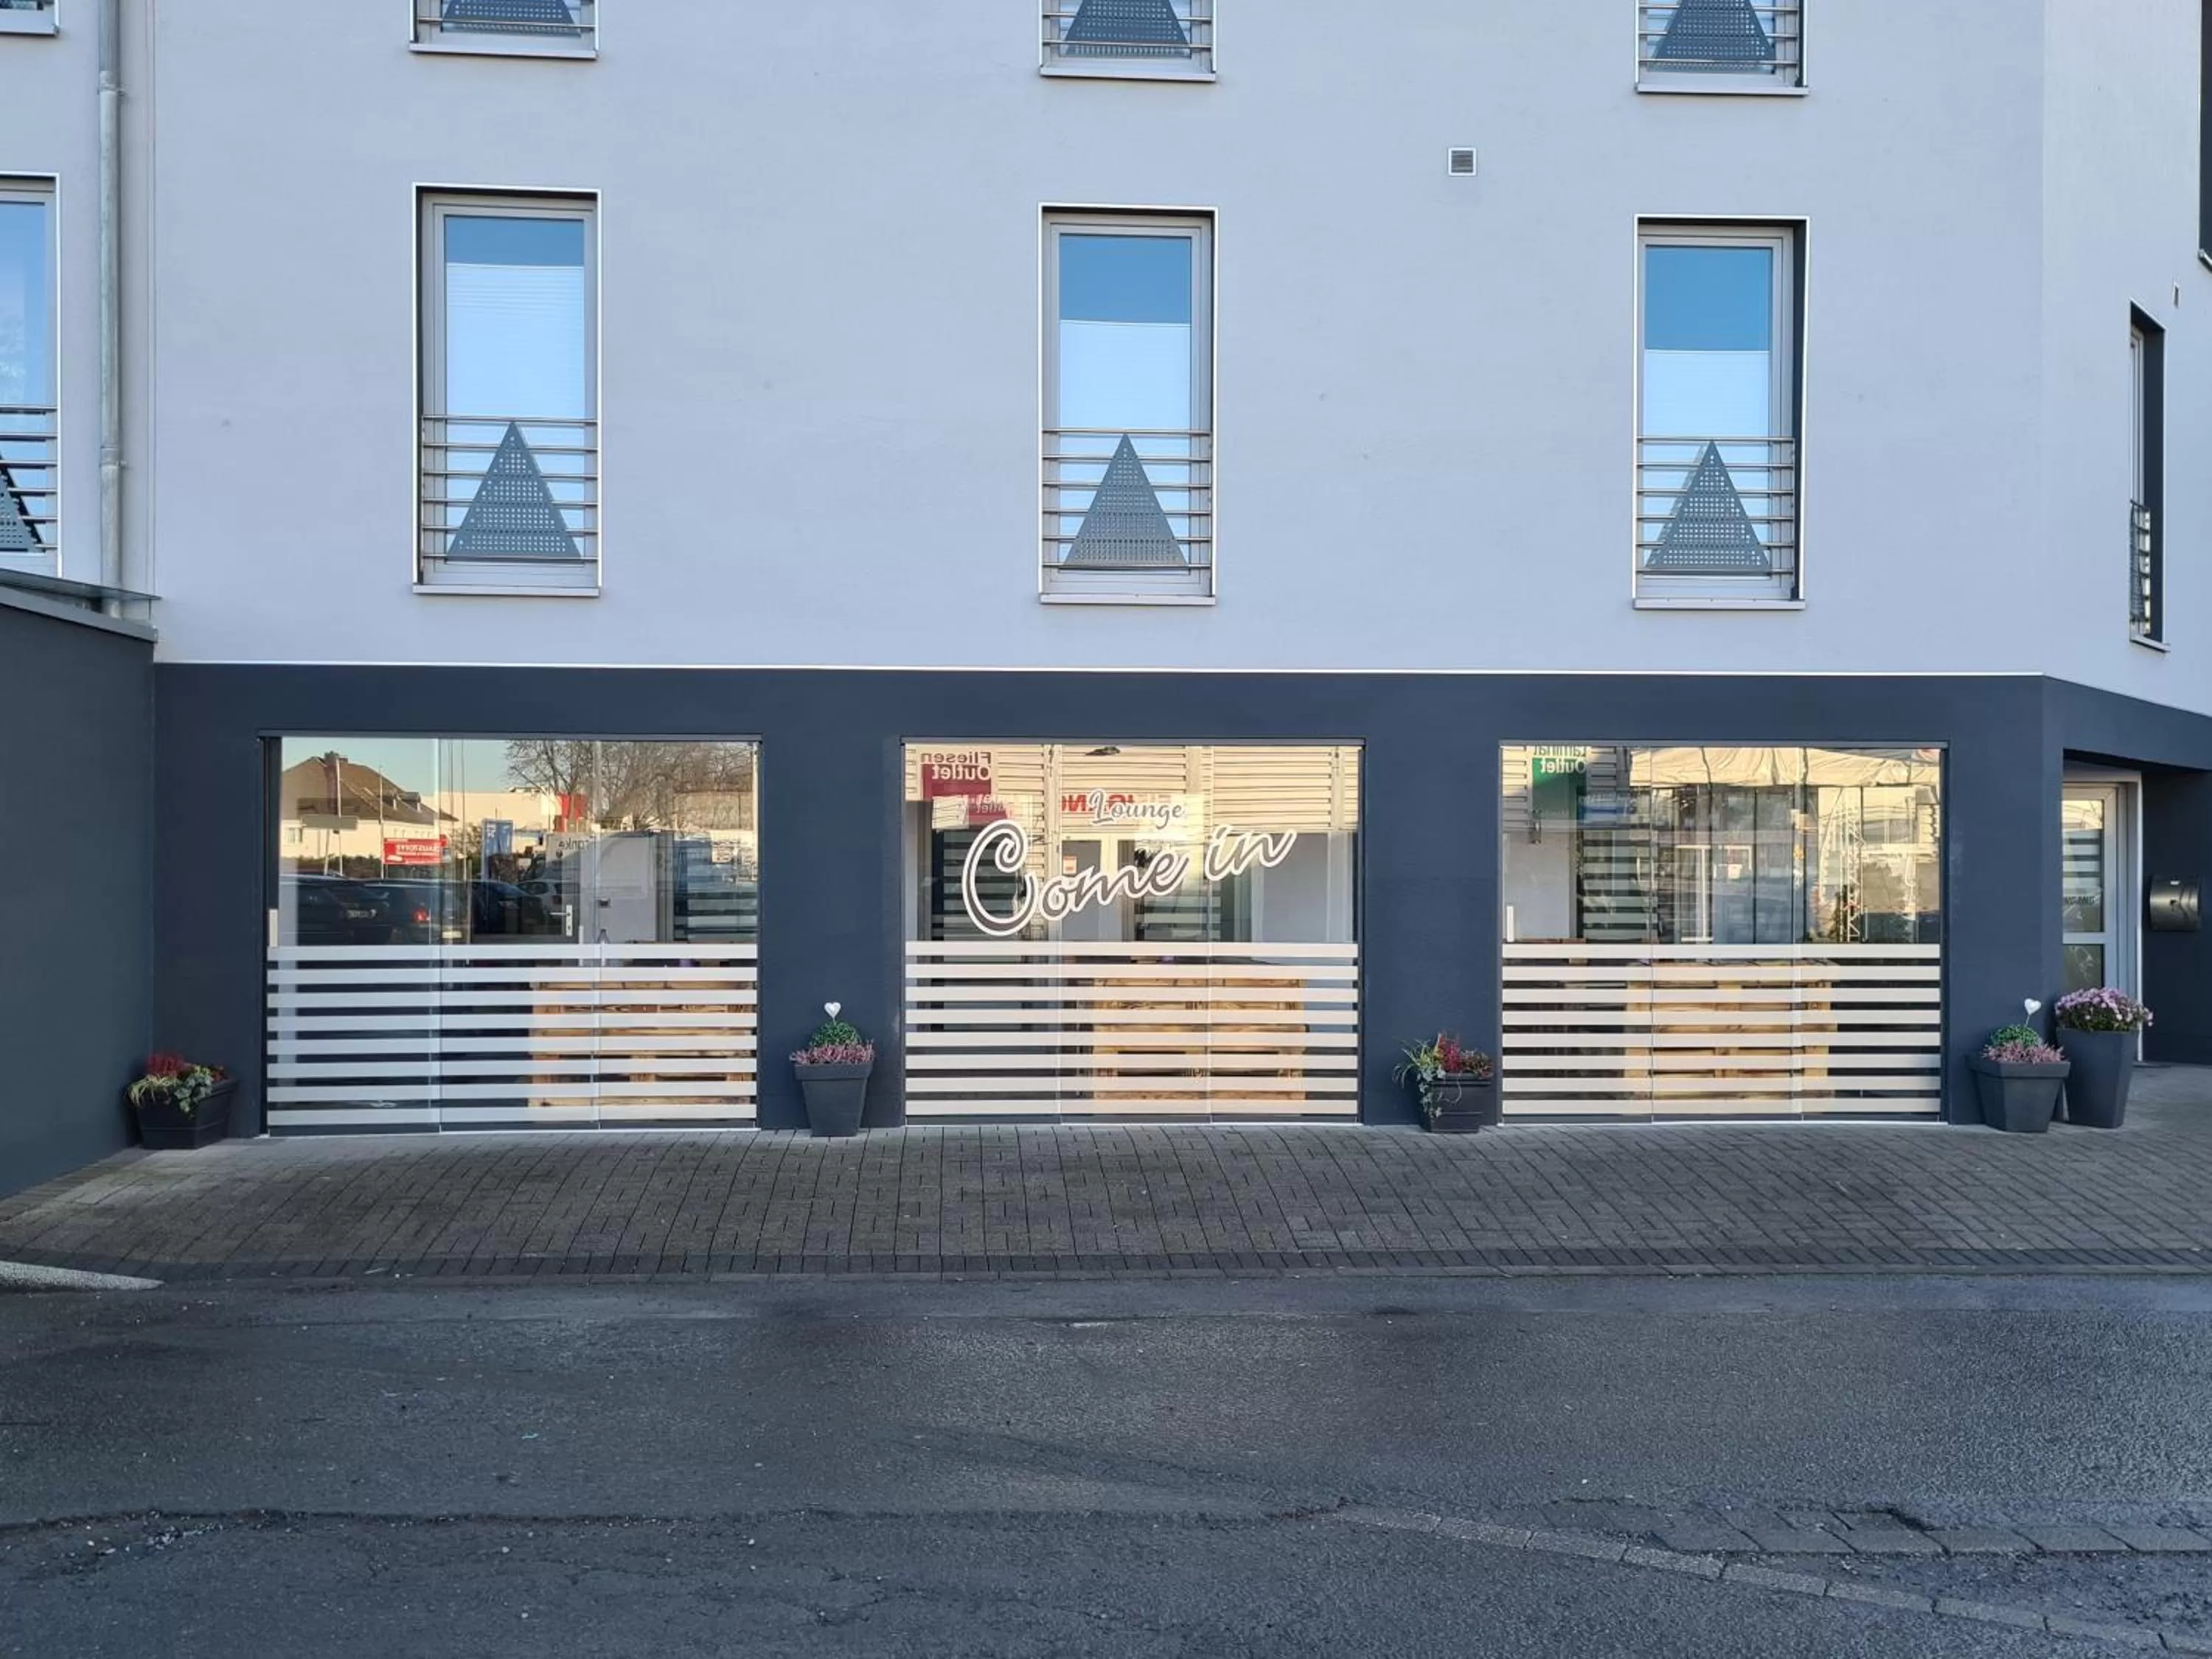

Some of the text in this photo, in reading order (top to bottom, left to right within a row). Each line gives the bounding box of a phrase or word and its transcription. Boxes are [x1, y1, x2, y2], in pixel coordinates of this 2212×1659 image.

[1088, 787, 1185, 830] Lounge
[961, 818, 1298, 937] Come in
